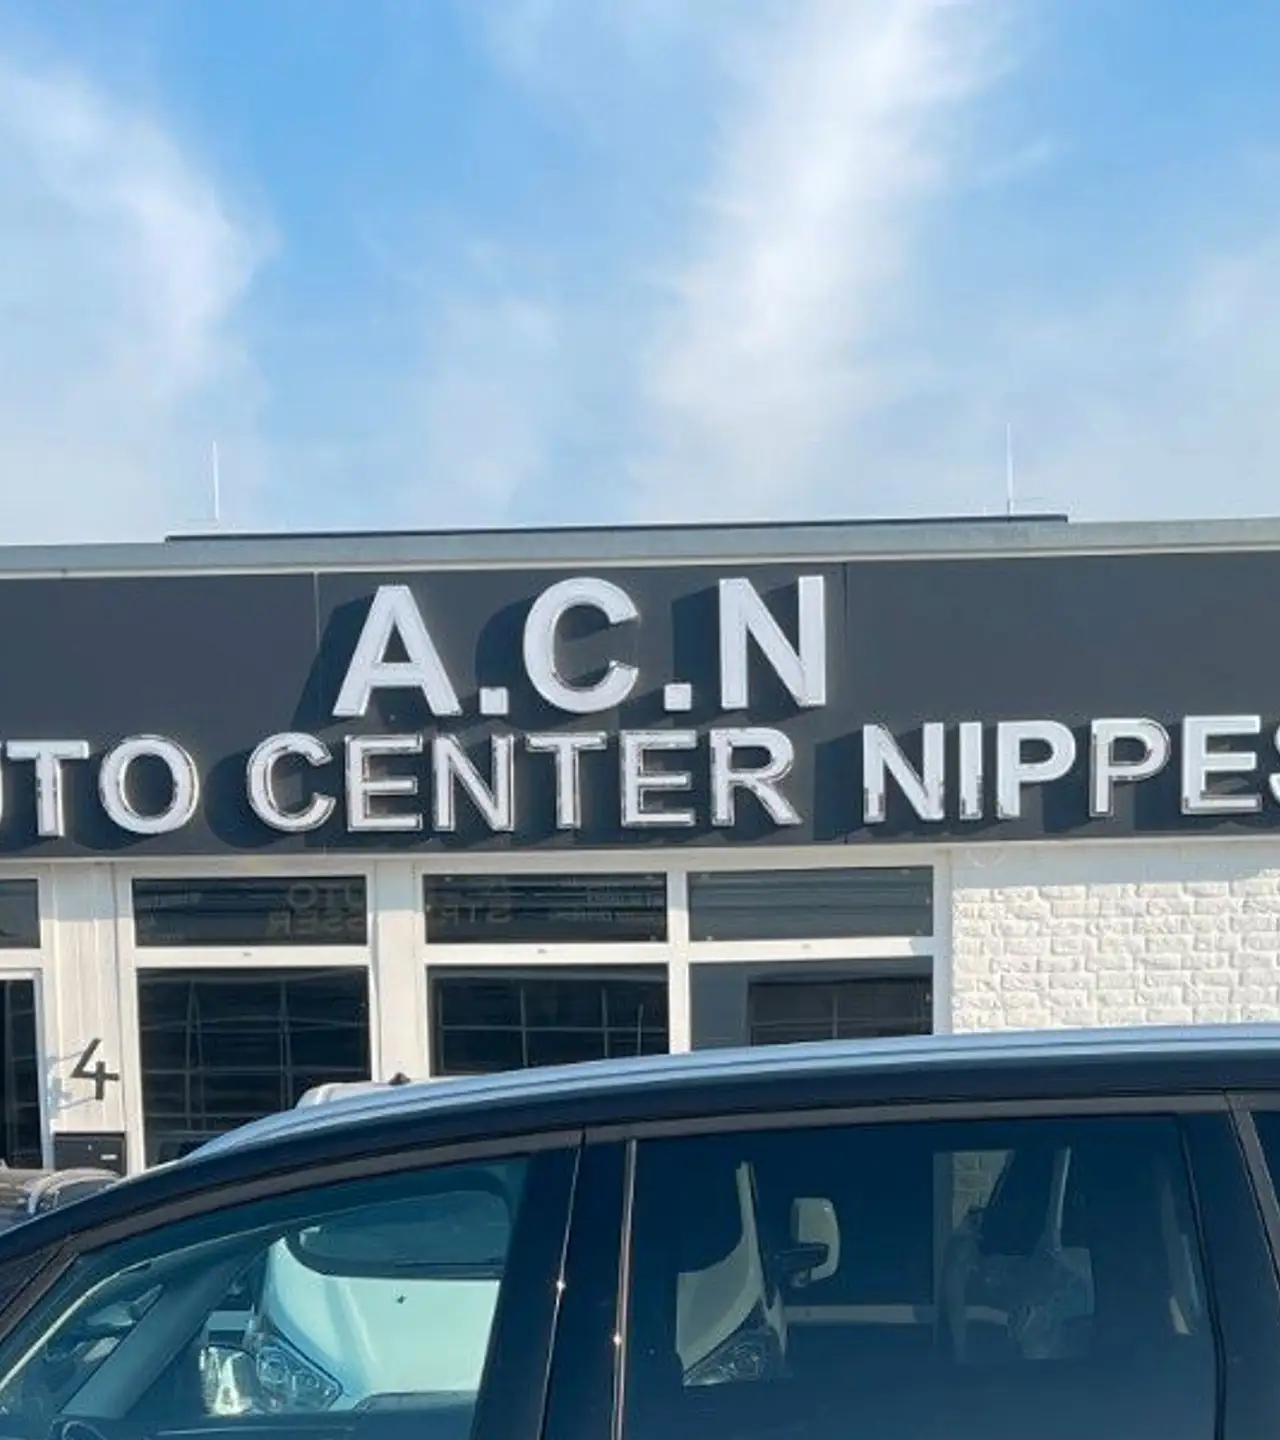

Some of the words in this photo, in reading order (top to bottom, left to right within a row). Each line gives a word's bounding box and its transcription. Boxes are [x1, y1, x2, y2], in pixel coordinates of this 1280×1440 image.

[333, 575, 826, 717] A.C.N
[246, 726, 803, 832] CENTER
[69, 1038, 120, 1101] 4
